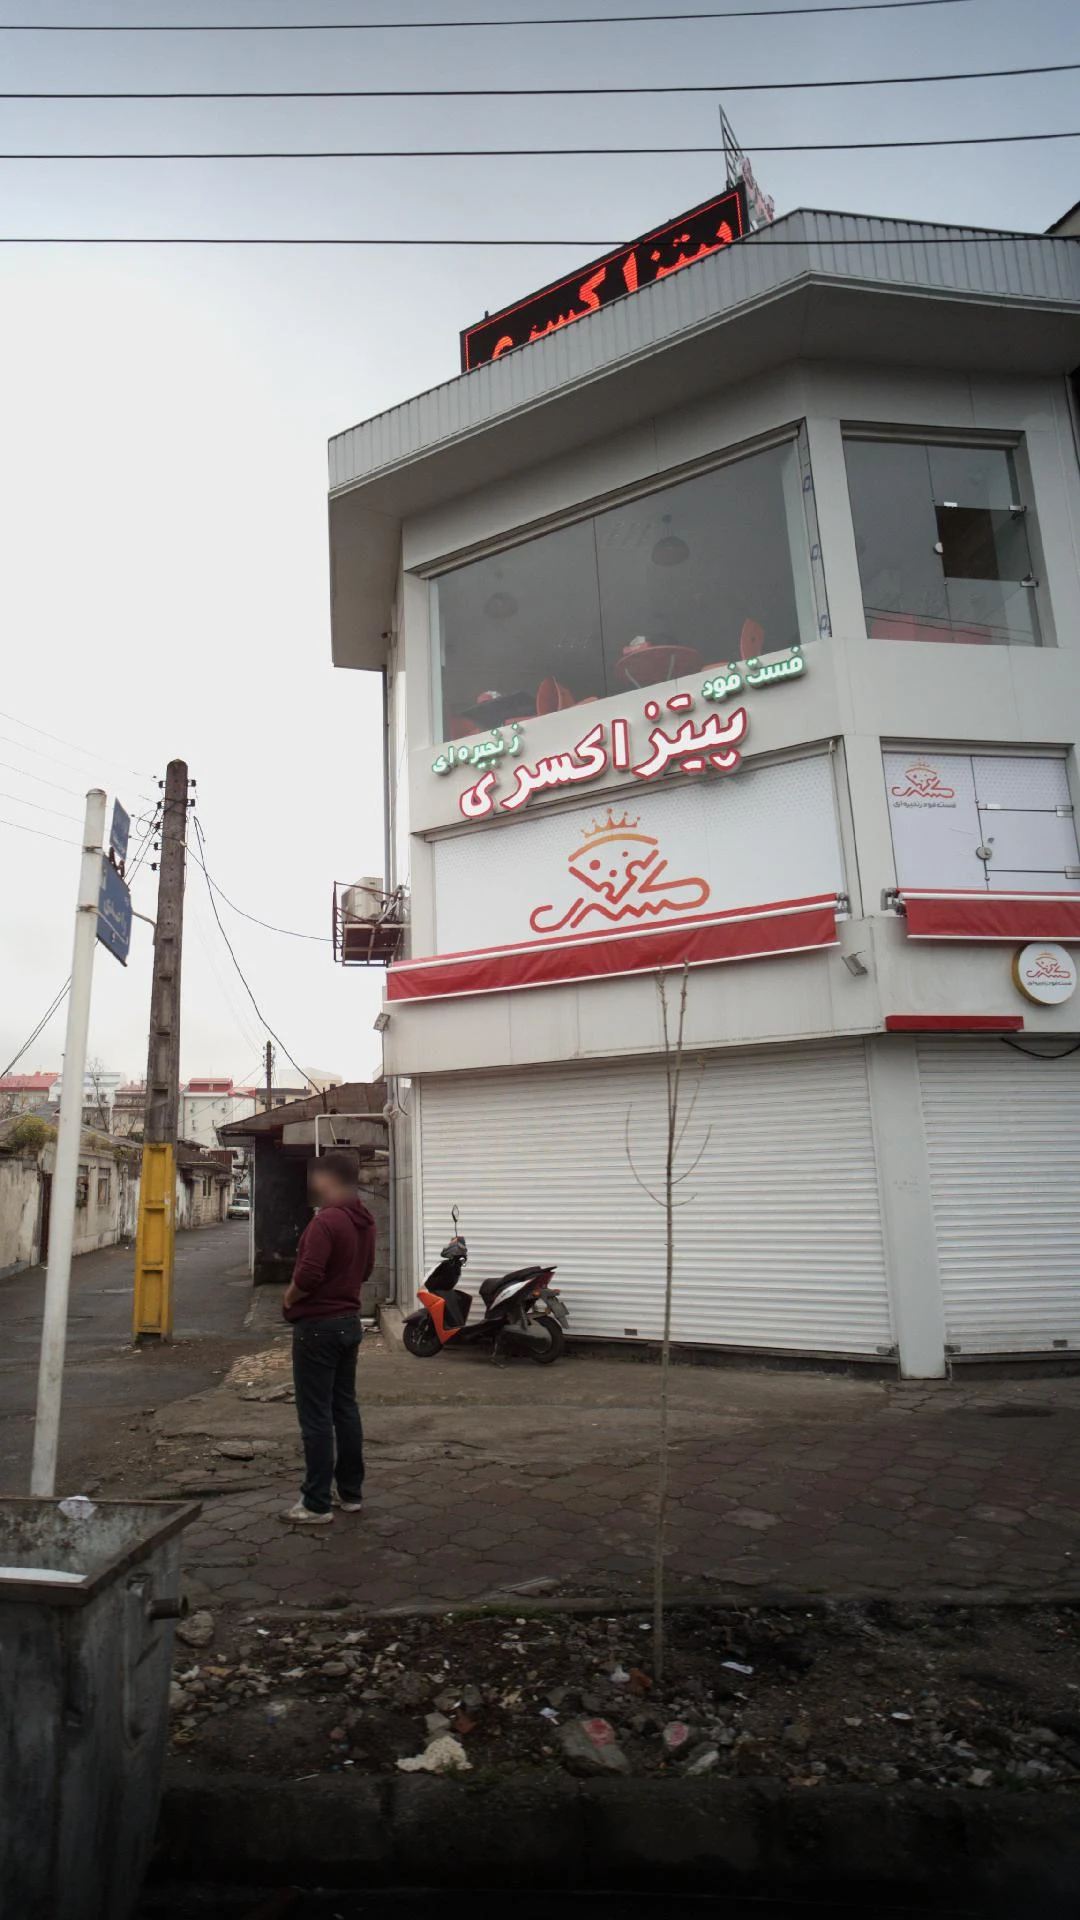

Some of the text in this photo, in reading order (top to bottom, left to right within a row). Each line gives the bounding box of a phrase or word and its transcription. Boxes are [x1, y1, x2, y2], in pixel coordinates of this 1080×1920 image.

[702, 645, 805, 700] فست فود
[459, 693, 748, 819] پیتزا کسری
